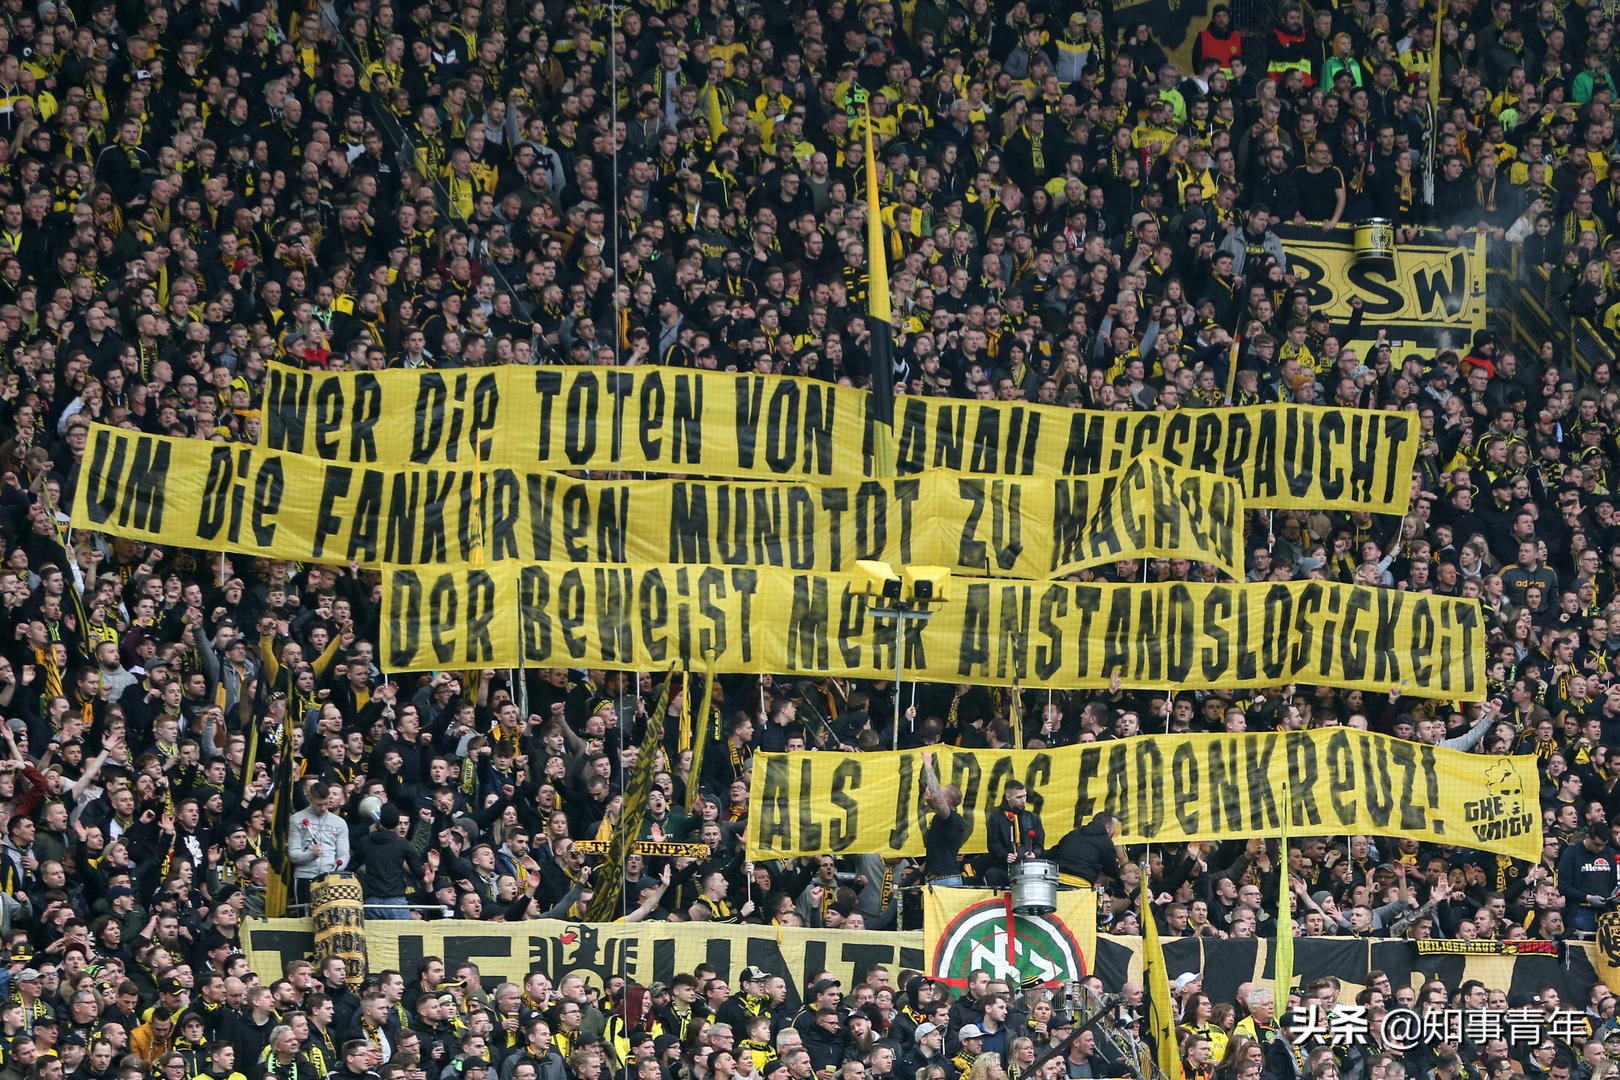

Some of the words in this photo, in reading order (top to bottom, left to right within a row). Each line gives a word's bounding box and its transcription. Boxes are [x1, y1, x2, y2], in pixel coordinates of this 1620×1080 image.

[1286, 252, 1465, 317] BSW
[734, 375, 836, 476] VON
[86, 430, 172, 534] UM
[669, 479, 920, 573] MUNDTOT
[957, 478, 1023, 571] ZU
[641, 842, 691, 858] UNITY
[758, 754, 864, 852] ALS
